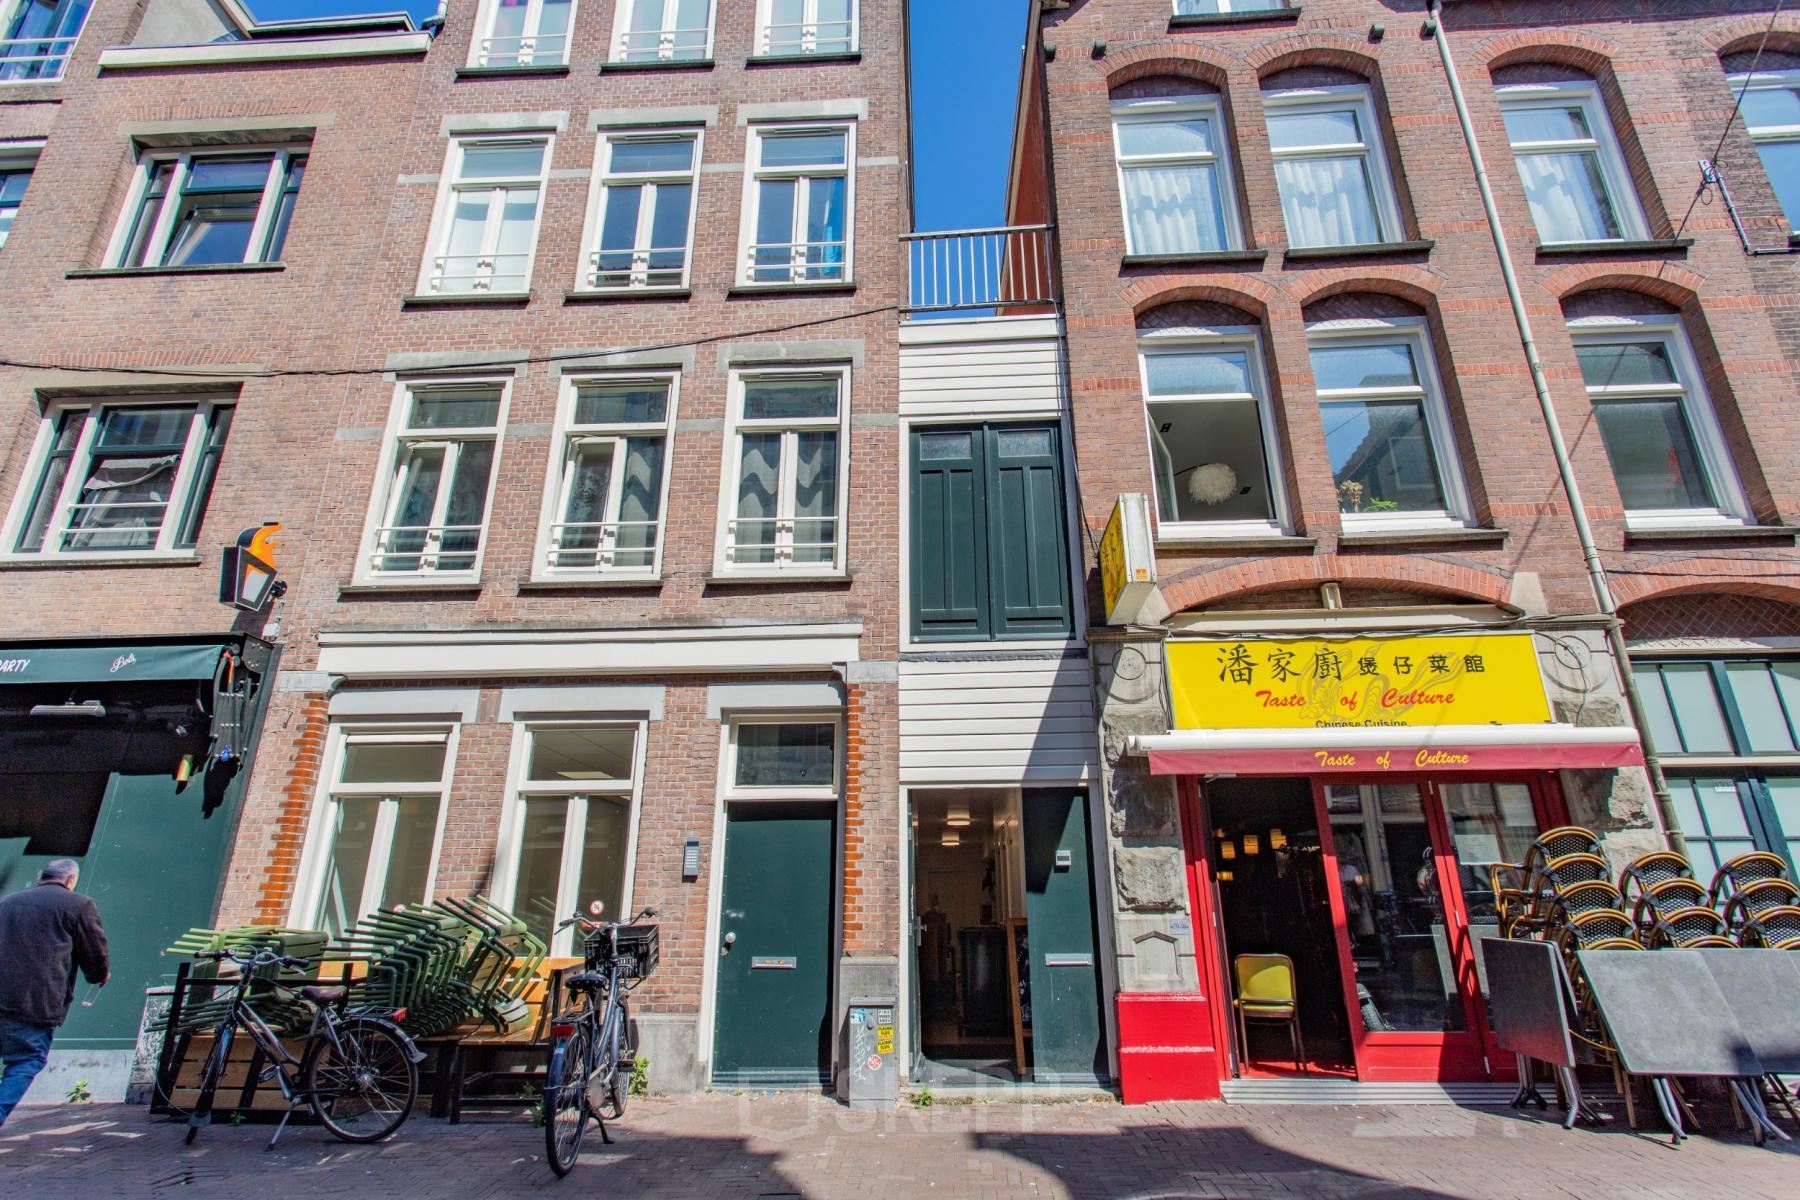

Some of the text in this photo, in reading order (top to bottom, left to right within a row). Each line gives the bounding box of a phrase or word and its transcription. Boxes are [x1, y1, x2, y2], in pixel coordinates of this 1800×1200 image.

[1255, 687, 1455, 711] Taste of Culture
[1315, 719, 1361, 728] Chinese
[1314, 749, 1469, 770] Taste of Culture
